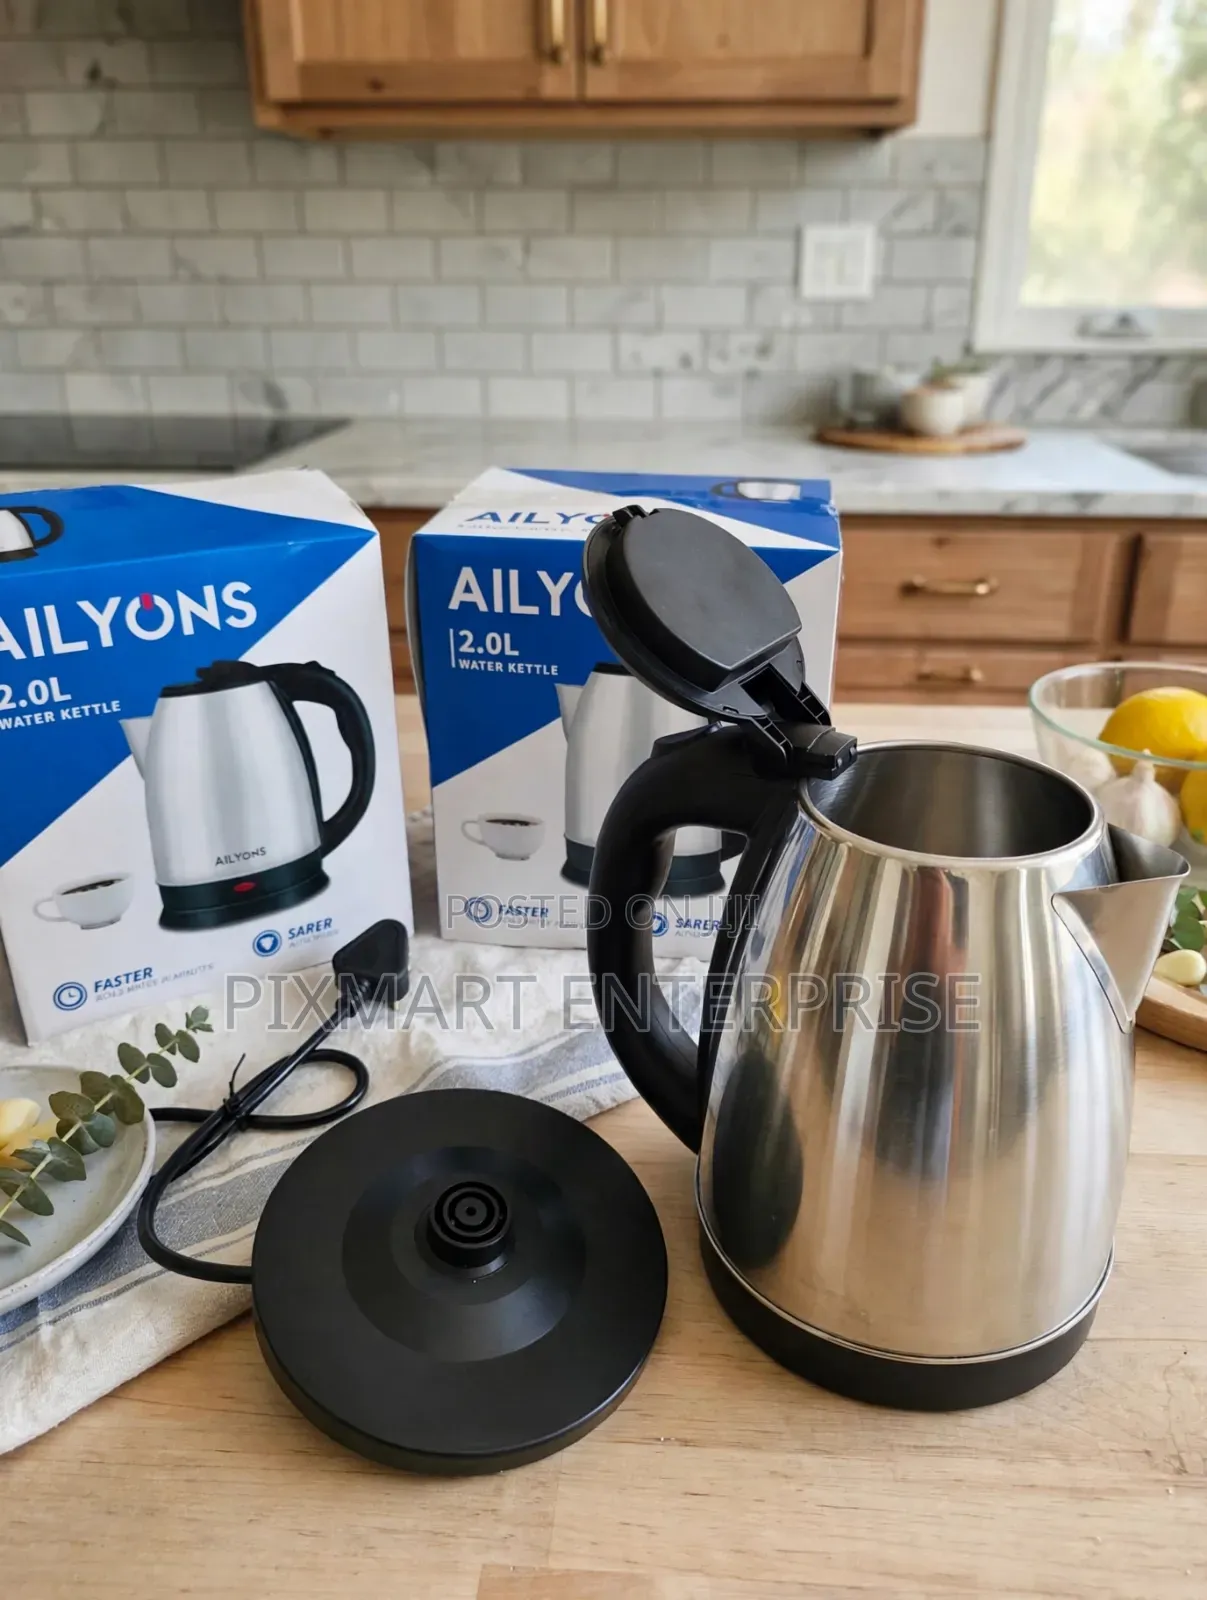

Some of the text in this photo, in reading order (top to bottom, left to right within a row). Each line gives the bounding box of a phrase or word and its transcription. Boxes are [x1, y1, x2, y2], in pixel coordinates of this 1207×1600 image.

[448, 566, 592, 618] AILY
[458, 629, 519, 657] 2.0L
[458, 659, 559, 676] WATER KETTLE
[0, 677, 72, 711] 2.0L
[0, 700, 121, 730] WATER KETTLE
[215, 846, 267, 866] AILYONS
[498, 904, 549, 918] FASTER
[288, 917, 333, 940] SARER
[94, 966, 154, 993] FASTER
